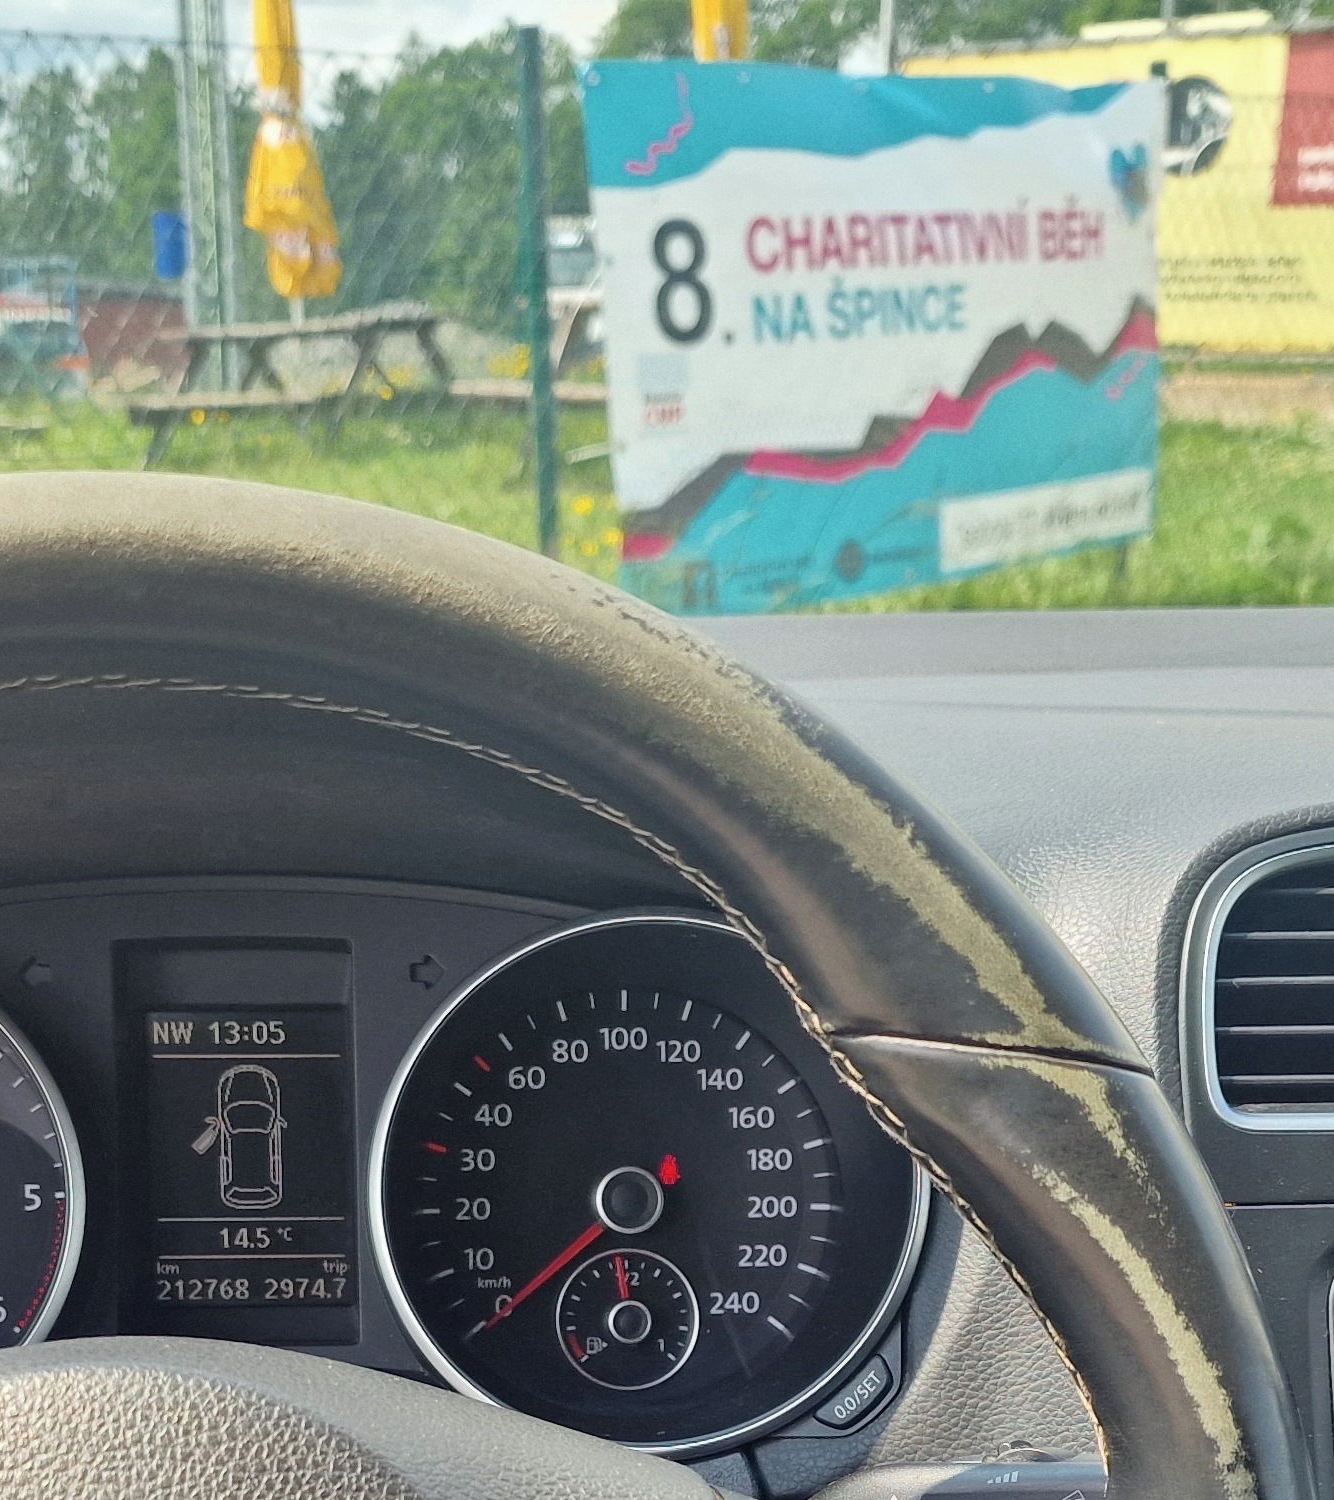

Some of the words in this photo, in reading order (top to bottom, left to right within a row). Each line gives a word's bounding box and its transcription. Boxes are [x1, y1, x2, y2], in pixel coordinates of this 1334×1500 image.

[745, 200, 1030, 272] CHARITATIVNÍ
[1039, 195, 1104, 260] BĚH
[753, 293, 814, 341] NA
[827, 276, 969, 338] ŠPINCE
[152, 1022, 193, 1045] NW
[209, 1021, 286, 1045] 13:05
[599, 1026, 648, 1052] 100
[551, 1039, 589, 1064] 80
[655, 1039, 701, 1063] 120
[507, 1066, 546, 1090] 60
[697, 1067, 744, 1091] 140
[474, 1104, 513, 1127] 40
[728, 1106, 776, 1129] 160
[461, 1148, 496, 1172] 30
[746, 1148, 793, 1171] 180
[23, 1184, 41, 1211] 5
[746, 1195, 798, 1219] 200
[455, 1198, 491, 1222] 20
[219, 1227, 271, 1249] 14.5
[322, 1260, 349, 1276] trip
[464, 1248, 494, 1271] 10
[737, 1244, 788, 1268] 220
[156, 1262, 180, 1275] km
[156, 1279, 250, 1300] 212768
[264, 1277, 347, 1299] 2974.7
[476, 1275, 512, 1291] km/h
[494, 1294, 513, 1317] 0
[709, 1291, 761, 1315] 240
[658, 1338, 665, 1352] 1
[834, 1370, 881, 1419] 0.0/SET
